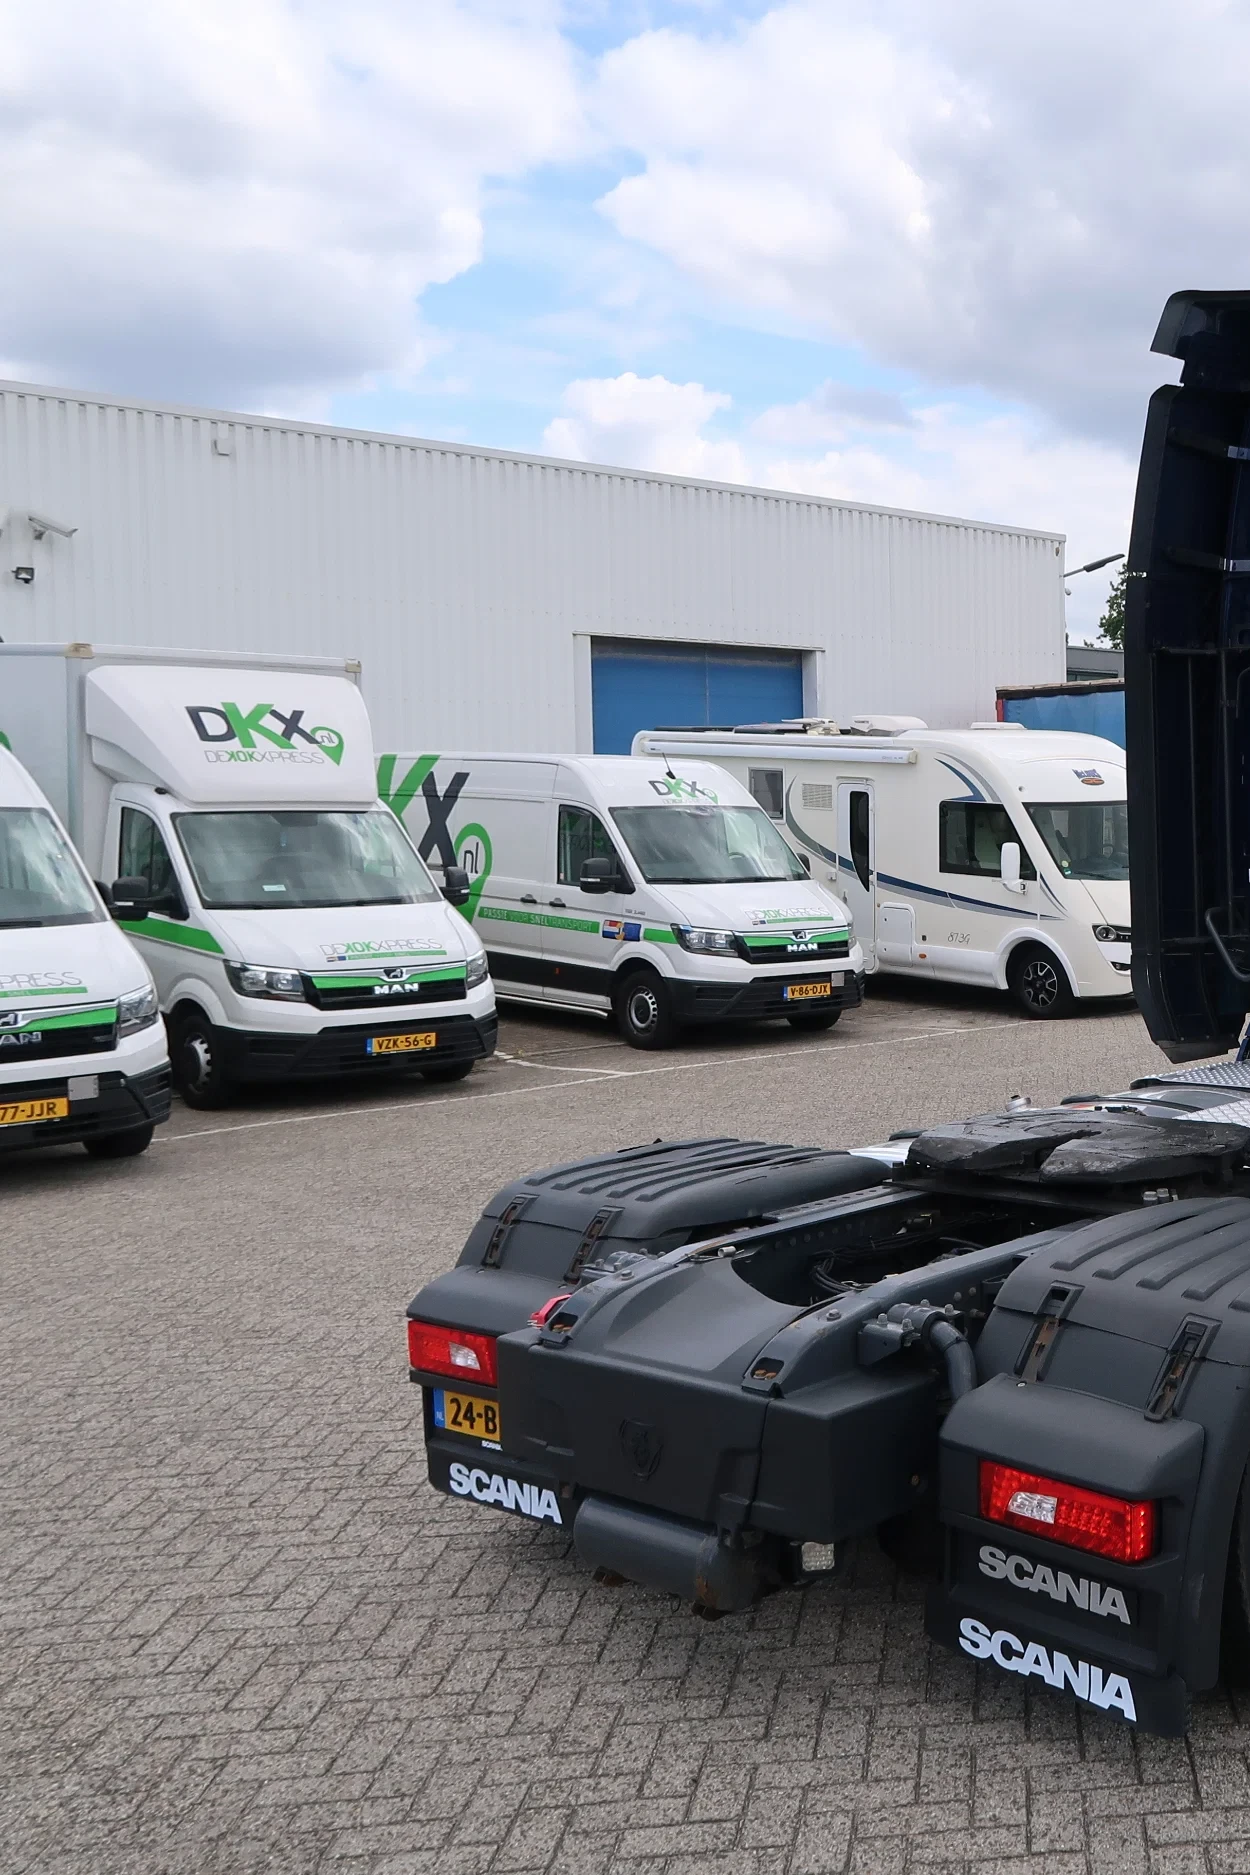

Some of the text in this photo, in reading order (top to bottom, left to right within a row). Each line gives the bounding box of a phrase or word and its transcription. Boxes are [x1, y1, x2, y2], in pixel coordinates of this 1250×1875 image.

[184, 702, 321, 749] DKX
[787, 943, 818, 953] MAN
[373, 983, 419, 995] MAN
[377, 1034, 432, 1051] VZK-56-G
[449, 1462, 563, 1525] SCANIA
[978, 1545, 1131, 1625] SCANIA
[958, 1617, 1137, 1722] SCANIA
